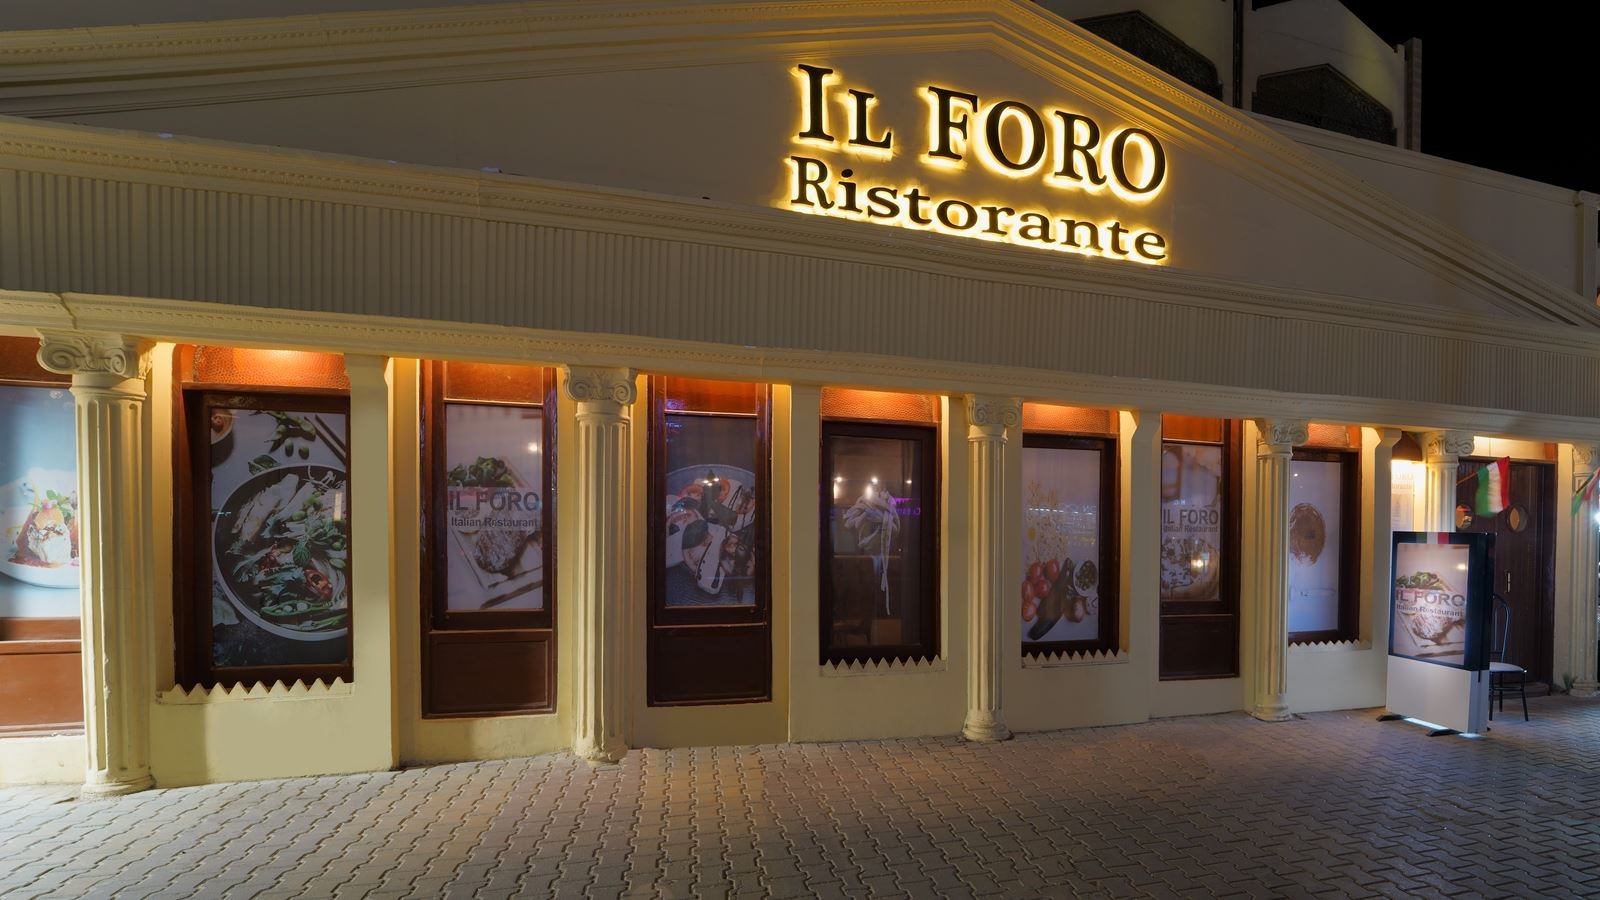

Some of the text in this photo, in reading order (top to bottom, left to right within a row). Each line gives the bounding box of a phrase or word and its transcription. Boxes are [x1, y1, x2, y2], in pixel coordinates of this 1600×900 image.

[798, 64, 1166, 194] IL FORO
[790, 155, 1167, 260] Ristorante
[449, 490, 540, 512] IL FORO
[451, 517, 538, 528] Italian Restaurant
[1163, 508, 1219, 525] IL FORO
[1396, 589, 1466, 607] IL FORO
[1396, 603, 1462, 617] Italian Restaurant
